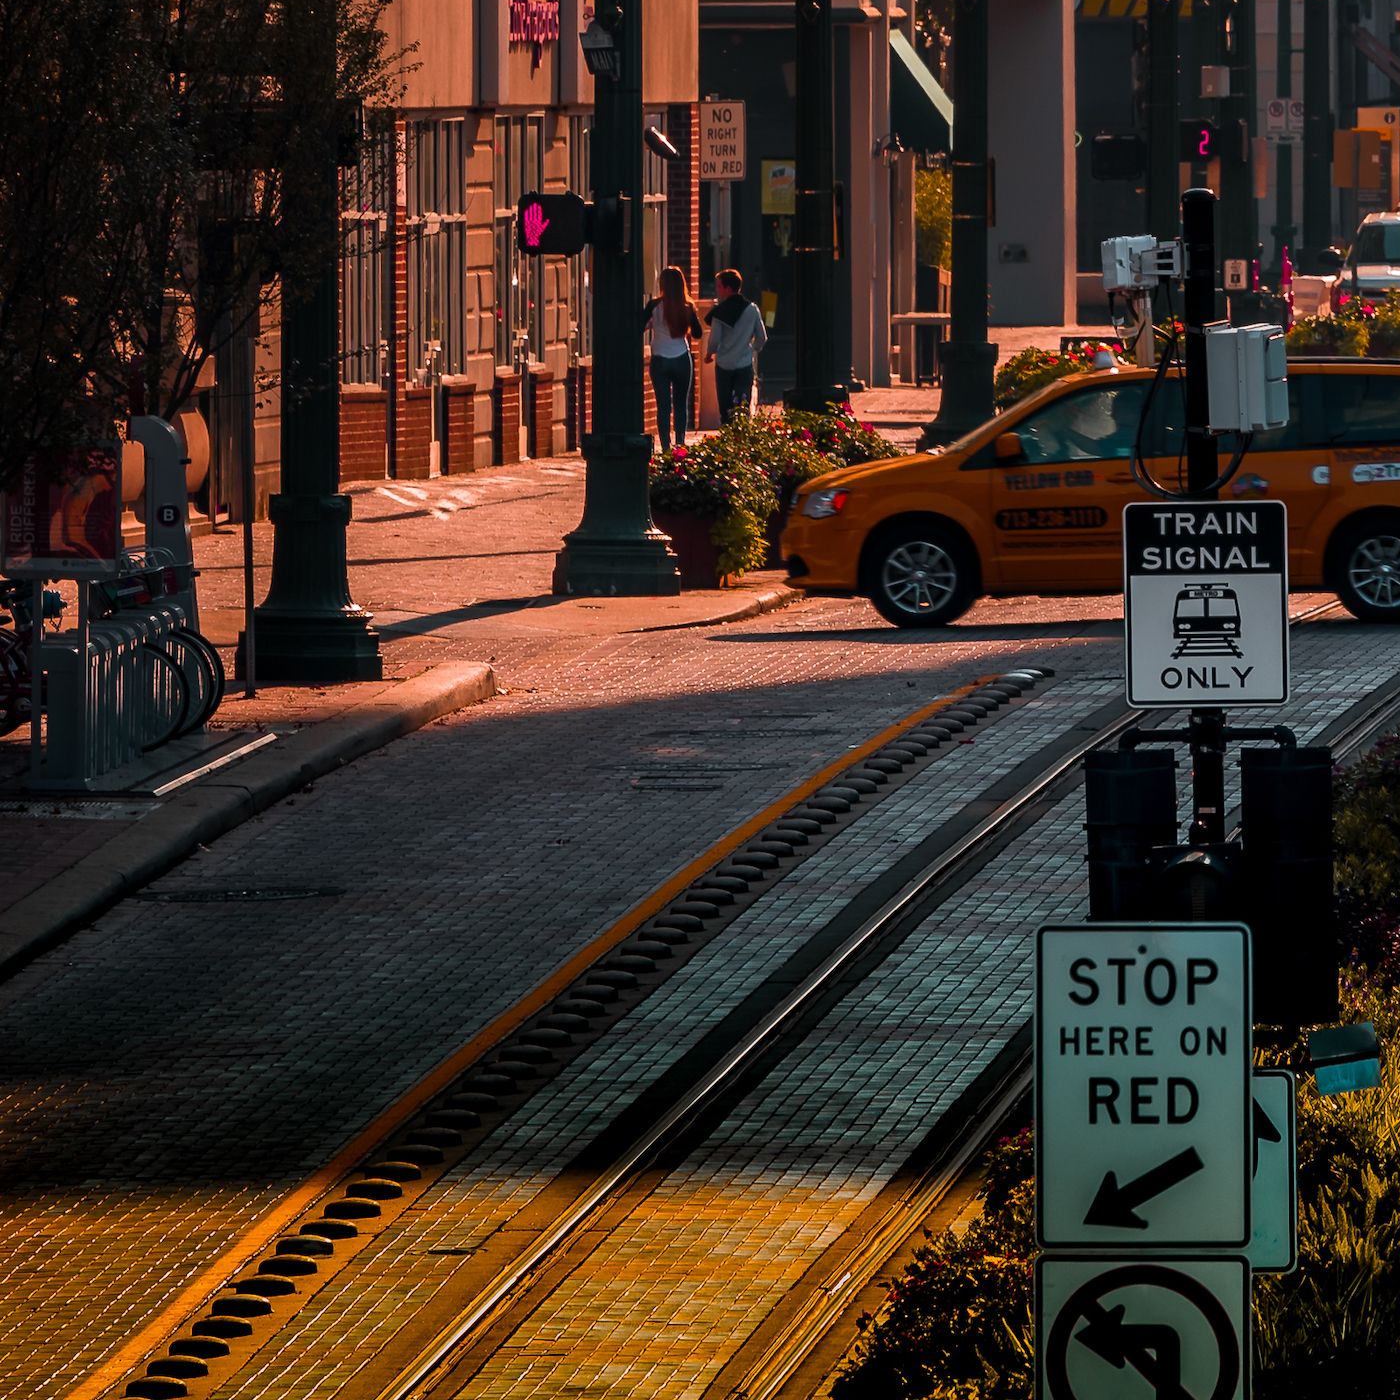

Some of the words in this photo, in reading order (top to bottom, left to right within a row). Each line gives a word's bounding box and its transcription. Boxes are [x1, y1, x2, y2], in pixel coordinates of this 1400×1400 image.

[711, 108, 732, 123] NO
[707, 128, 737, 140] RIGHT
[709, 144, 737, 157] TURN
[702, 162, 716, 174] ON
[721, 161, 742, 175] RED
[1005, 472, 1060, 490] YELLOW
[22, 454, 37, 544] DIFFEREN
[9, 503, 23, 543] RIDE
[1153, 511, 1258, 536] TRAIN
[1141, 546, 1271, 570] SIGNAL
[1160, 666, 1254, 689] ONLY
[1068, 958, 1219, 1006] STOP
[1059, 1027, 1154, 1056] HERE
[1179, 1027, 1227, 1056] ON
[1088, 1077, 1200, 1125] RED
